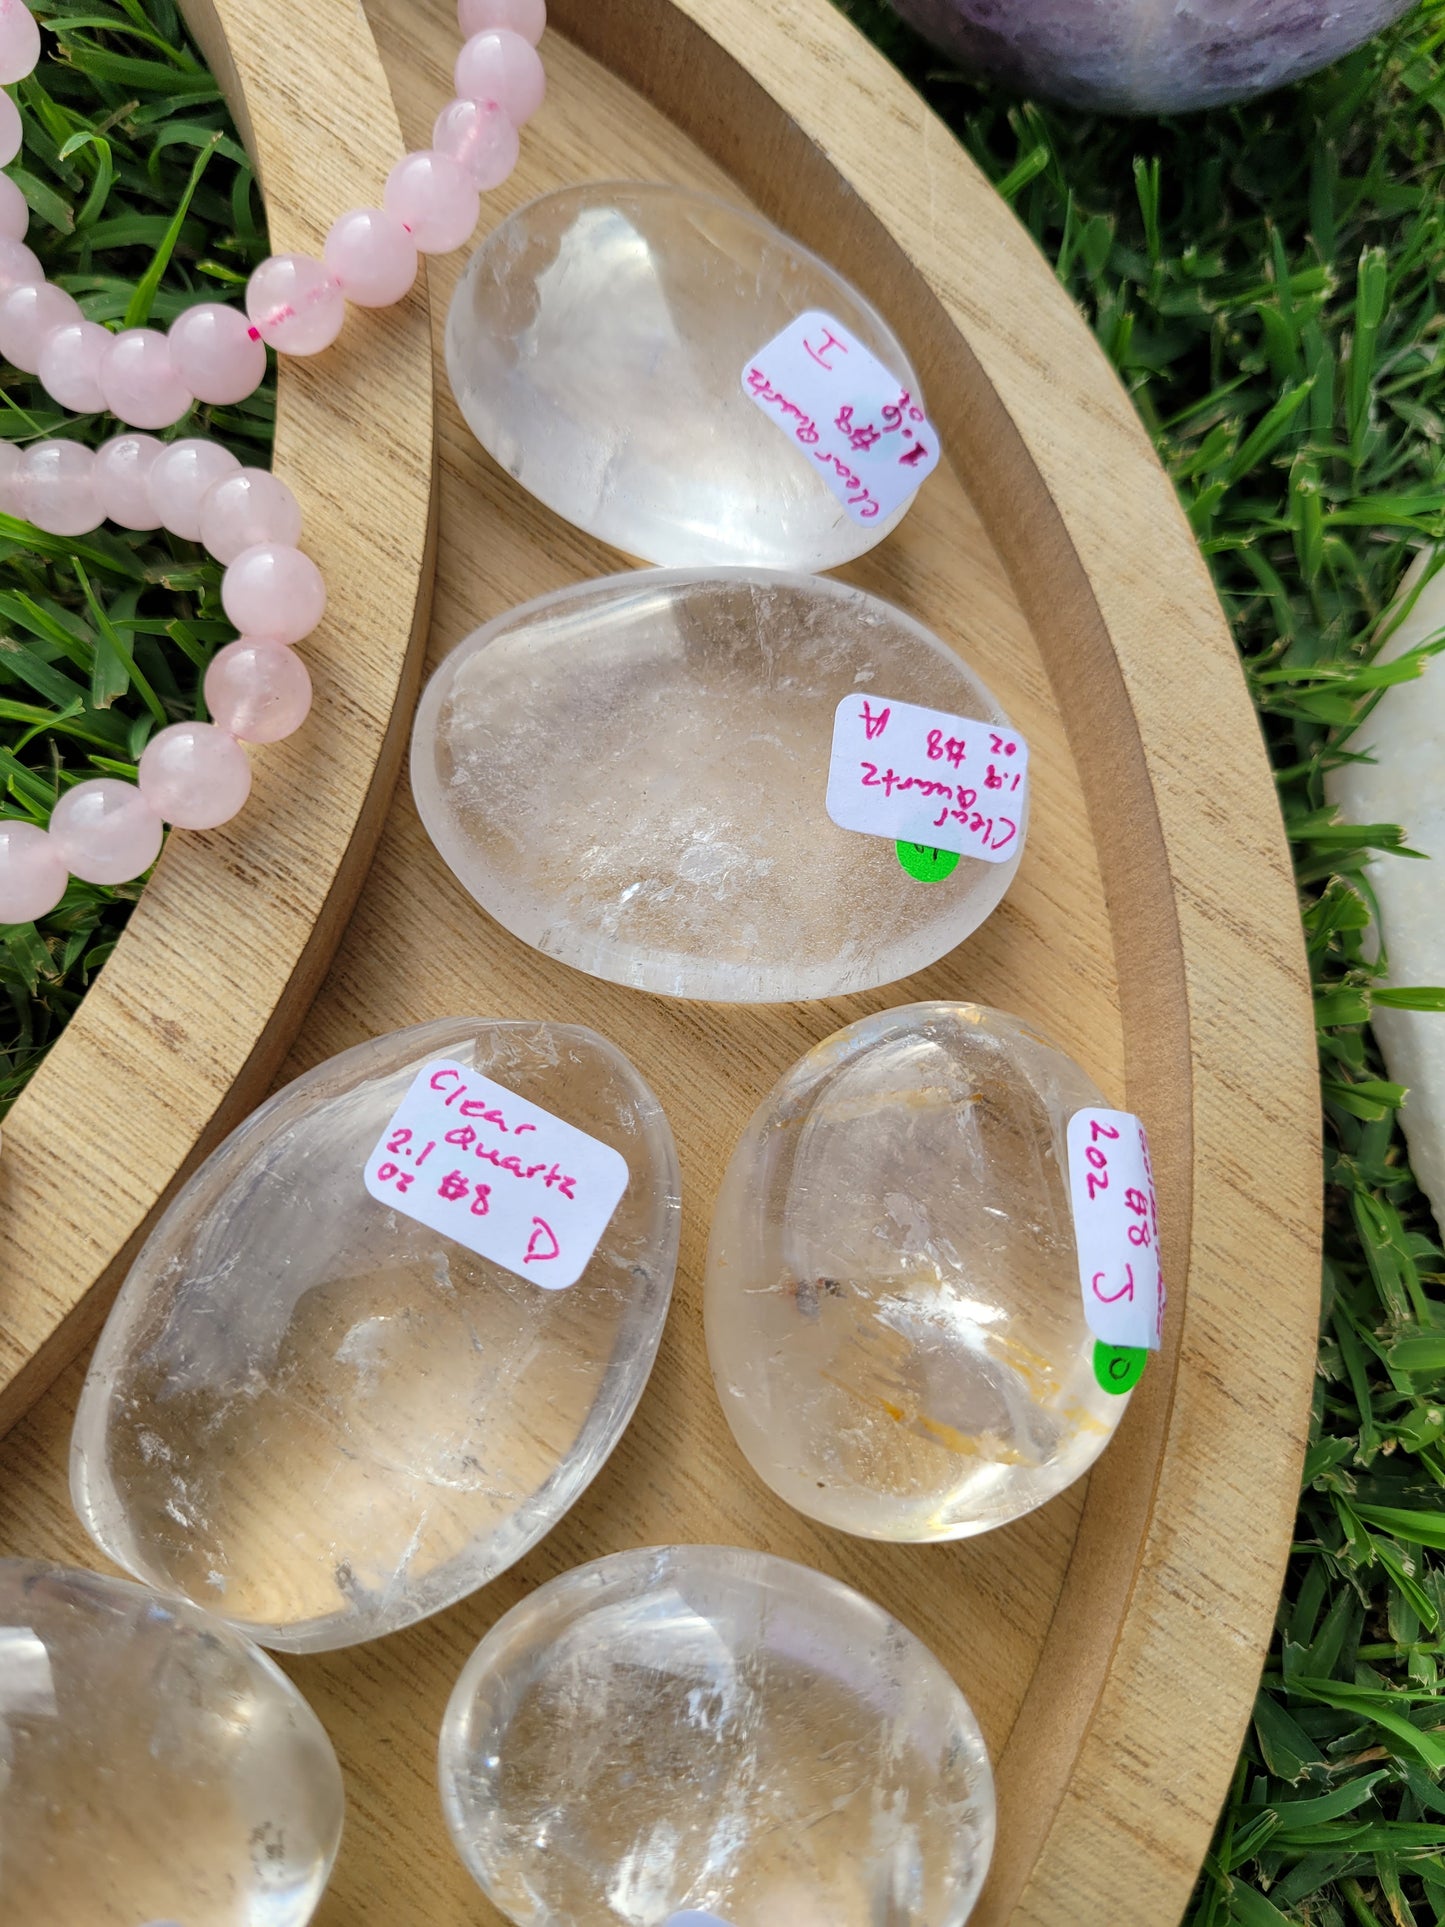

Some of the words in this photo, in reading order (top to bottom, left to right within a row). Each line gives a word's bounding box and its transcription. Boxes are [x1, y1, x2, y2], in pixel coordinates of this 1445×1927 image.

[814, 450, 881, 518] Clear
[857, 700, 892, 741] A
[860, 761, 978, 811] Quartz
[932, 806, 1017, 851] Clear
[428, 1069, 538, 1136] Clear
[385, 1127, 437, 1167] 2.1
[443, 1123, 578, 1200] Quartz
[522, 1215, 561, 1265] D
[1092, 1262, 1136, 1304] J
